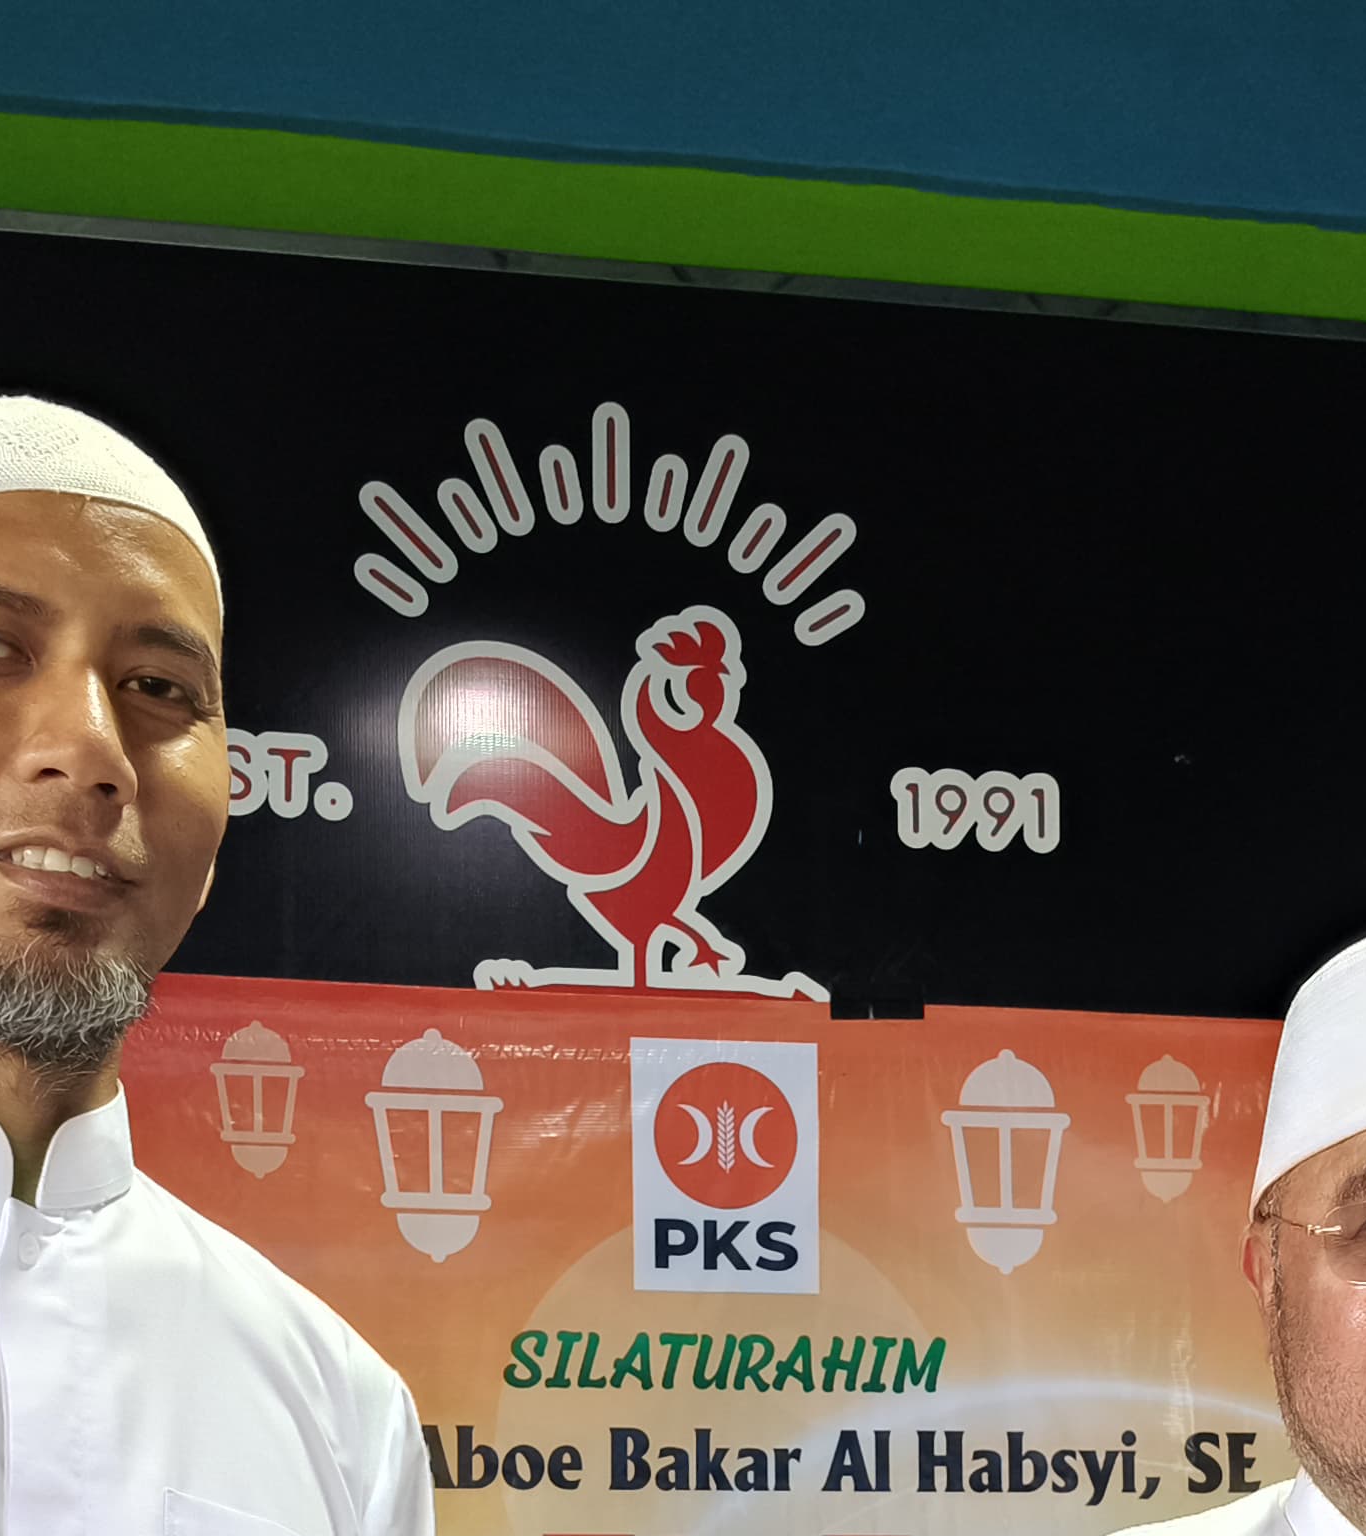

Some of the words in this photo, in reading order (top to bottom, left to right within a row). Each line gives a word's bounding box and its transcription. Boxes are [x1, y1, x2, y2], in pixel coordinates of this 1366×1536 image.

[893, 770, 1057, 851] 1991
[654, 1218, 799, 1272] PKS
[503, 1330, 947, 1394] SILATURAHIM
[609, 1427, 802, 1492] Bakar
[821, 1430, 891, 1492] Al
[916, 1430, 1161, 1506] Habsyi,
[1185, 1432, 1262, 1494] SE
